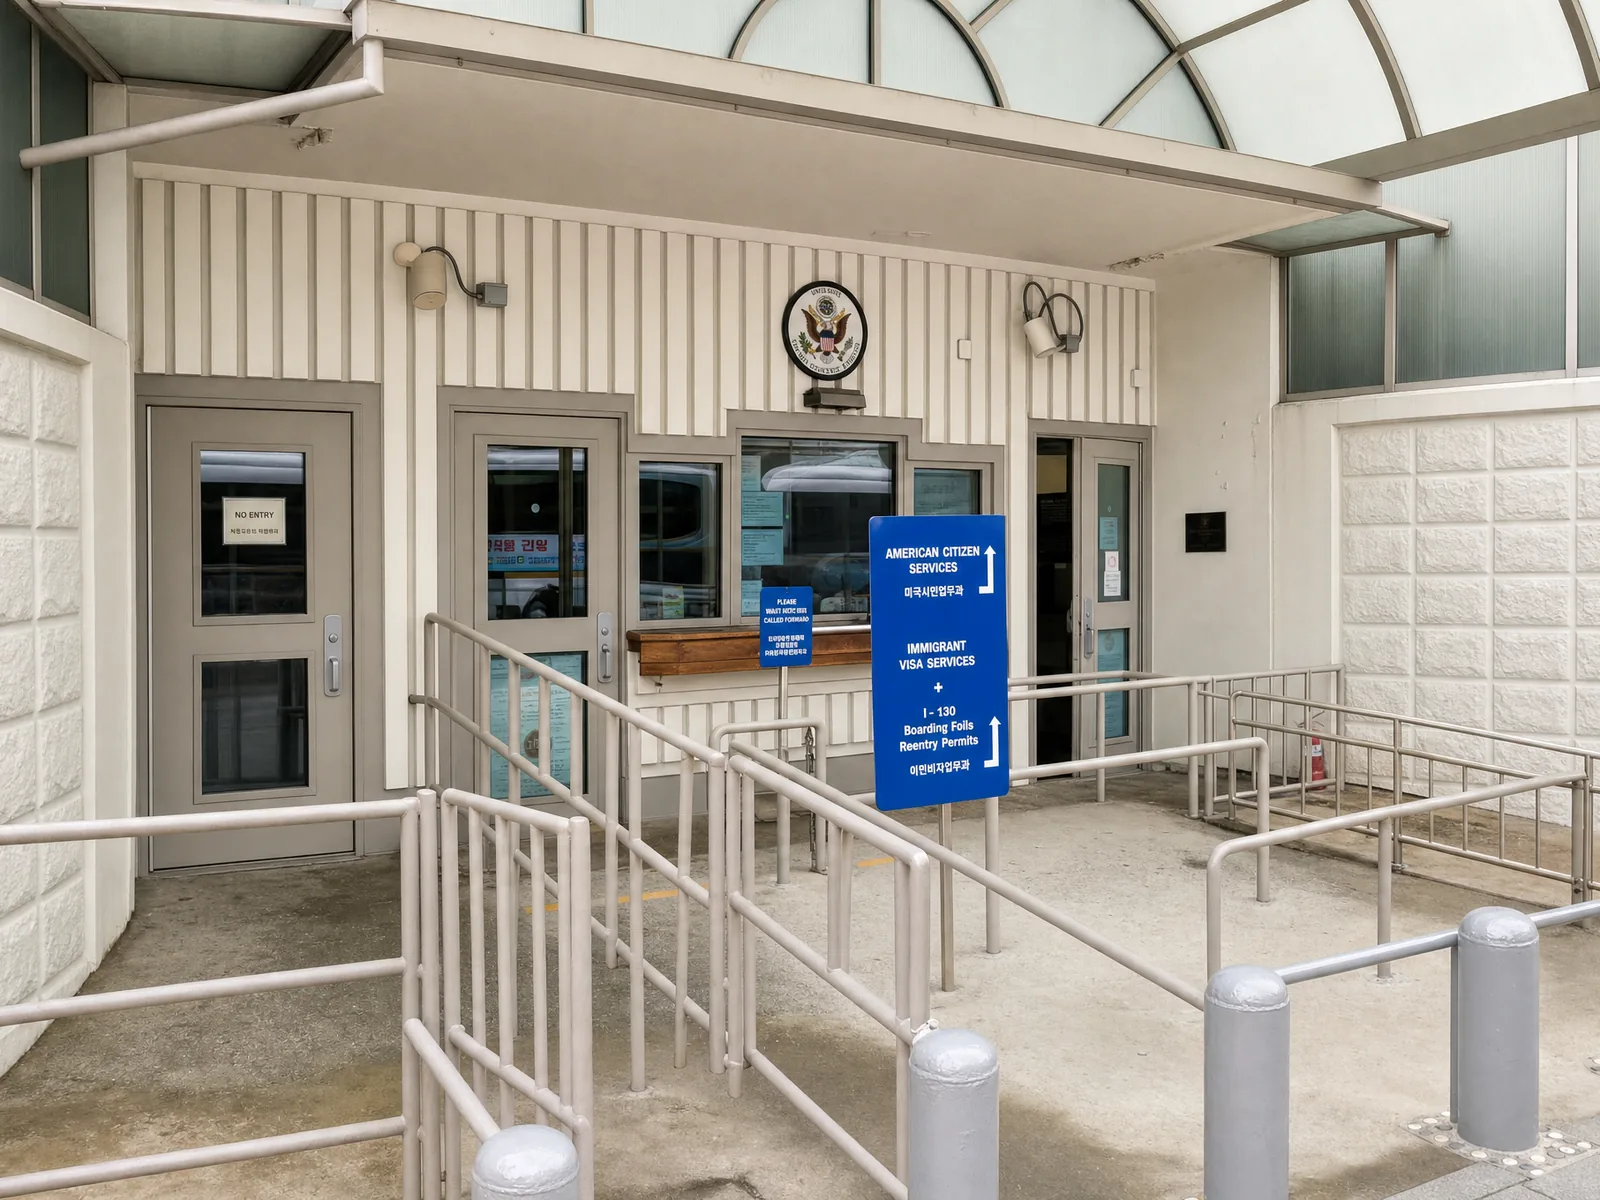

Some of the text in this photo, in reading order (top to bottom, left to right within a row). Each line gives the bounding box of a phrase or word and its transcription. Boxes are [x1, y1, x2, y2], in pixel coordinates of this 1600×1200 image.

[235, 511, 275, 519] NO ENTRY
[886, 546, 979, 559] AMERICAN CITIZEN
[910, 562, 957, 574] SERVICES
[908, 640, 966, 654] IMMIGRANT
[899, 656, 975, 670] VISA SERVICES
[936, 705, 956, 717] 130
[904, 720, 973, 735] Boarding Foils
[900, 735, 978, 752] Reentry Permits
